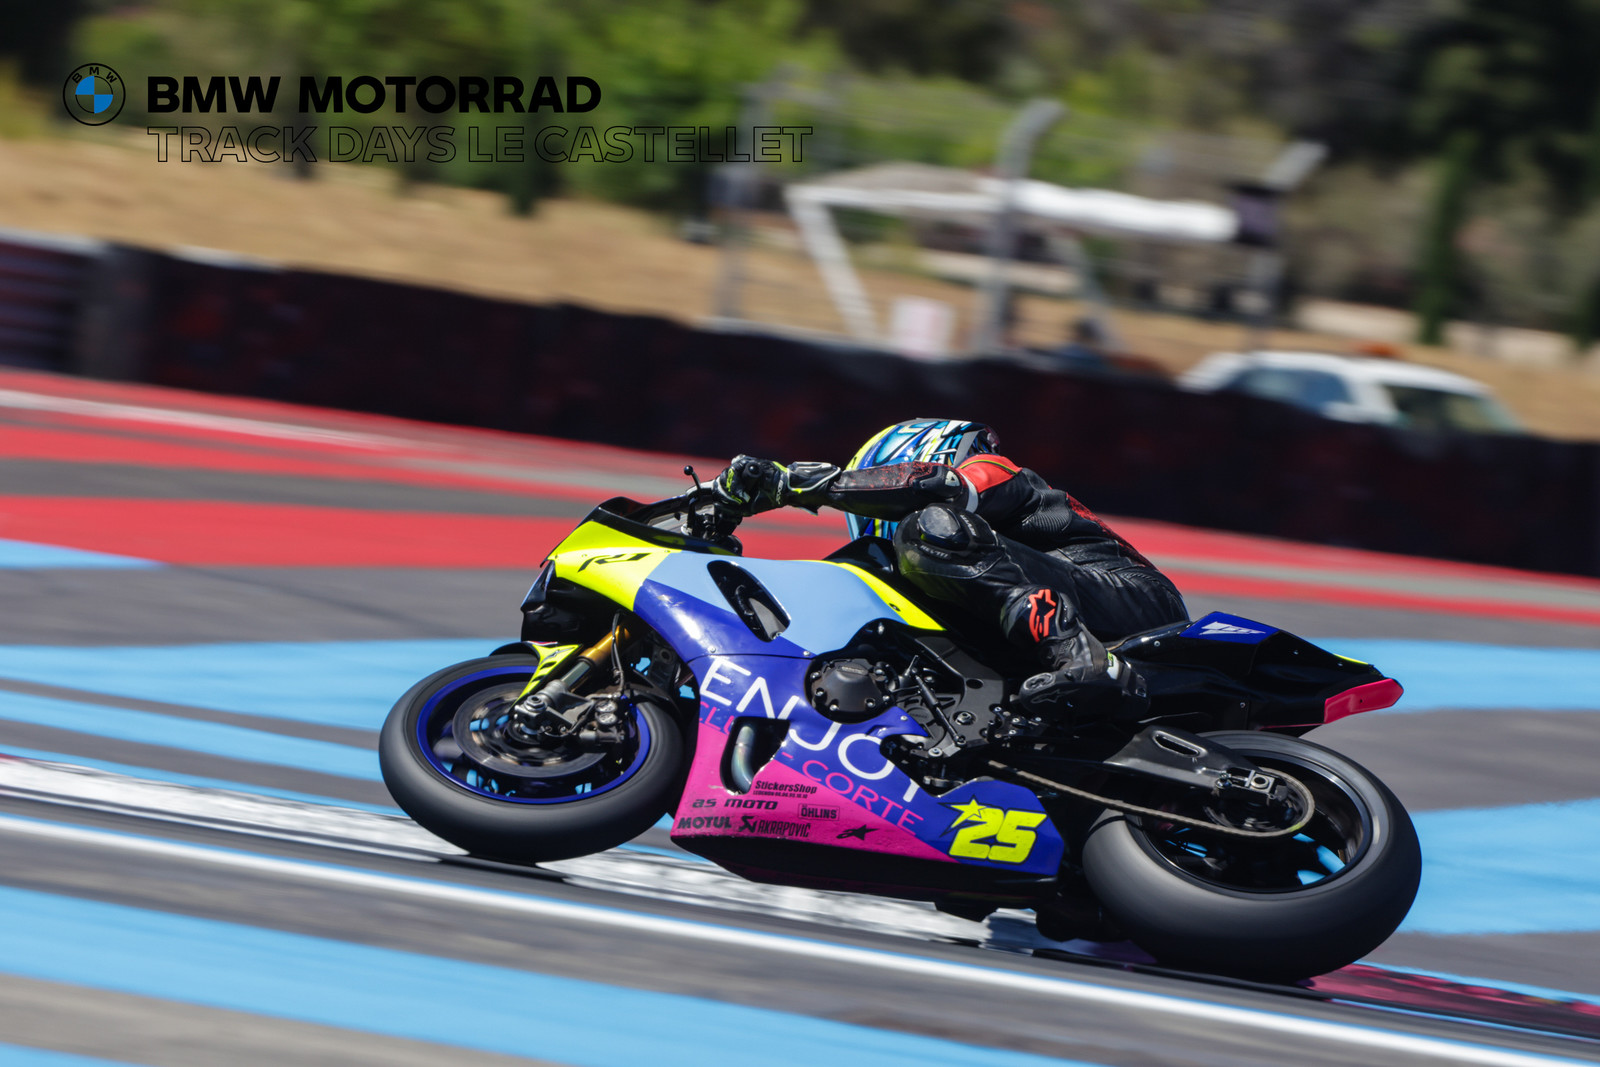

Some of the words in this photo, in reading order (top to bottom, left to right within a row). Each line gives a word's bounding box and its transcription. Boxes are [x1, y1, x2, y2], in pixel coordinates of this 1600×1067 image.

[700, 656, 920, 803] ENJO
[755, 780, 818, 794] StickersShop
[802, 759, 924, 836] CORTE
[677, 817, 732, 829] MOTUL
[801, 804, 837, 819] ÖHLINS
[949, 805, 1047, 863] 25
